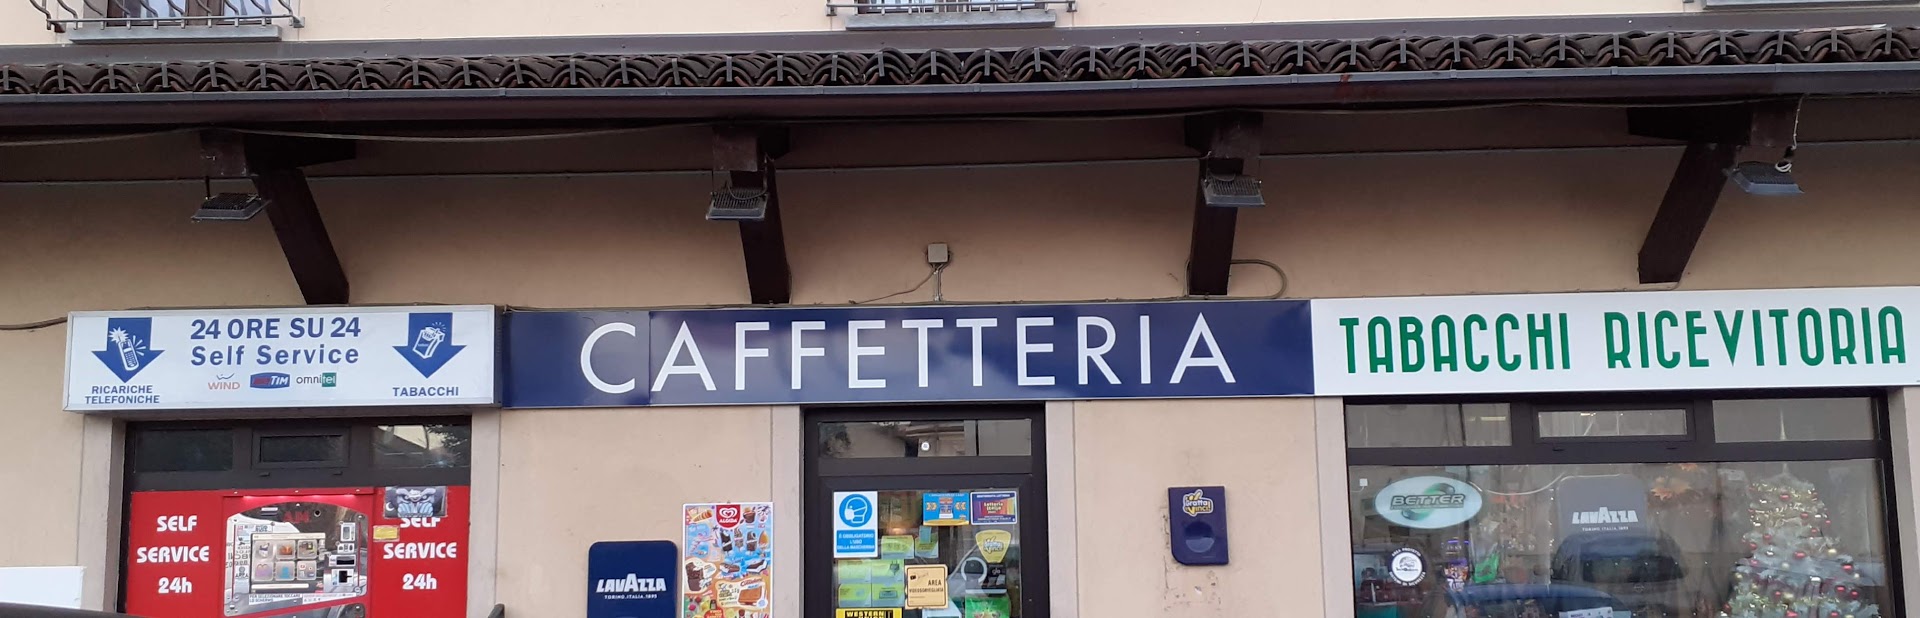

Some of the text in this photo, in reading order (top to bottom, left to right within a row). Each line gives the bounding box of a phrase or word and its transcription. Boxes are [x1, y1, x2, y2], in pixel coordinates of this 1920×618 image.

[190, 317, 361, 340] 24 ORE SU 24
[1339, 305, 1907, 374] TABACCHI RICEVITORIA
[190, 344, 359, 366] Self Service
[580, 312, 1237, 394] CAFFETTERIA
[208, 382, 240, 390] WIND
[270, 375, 289, 385] TIM
[296, 373, 336, 385] omnitel
[92, 385, 153, 395] RICARICHE
[392, 386, 459, 397] TABACCHI
[85, 395, 160, 405] TELEFONICHE
[1391, 494, 1465, 506] BETTER
[157, 515, 198, 532] SELF
[1572, 507, 1638, 524] LAVAZZA
[136, 545, 210, 563] SERVICE
[382, 542, 458, 559] SERVICE
[158, 577, 193, 594] 24h
[401, 573, 437, 590] 24h
[596, 573, 667, 593] LAVAZZA
